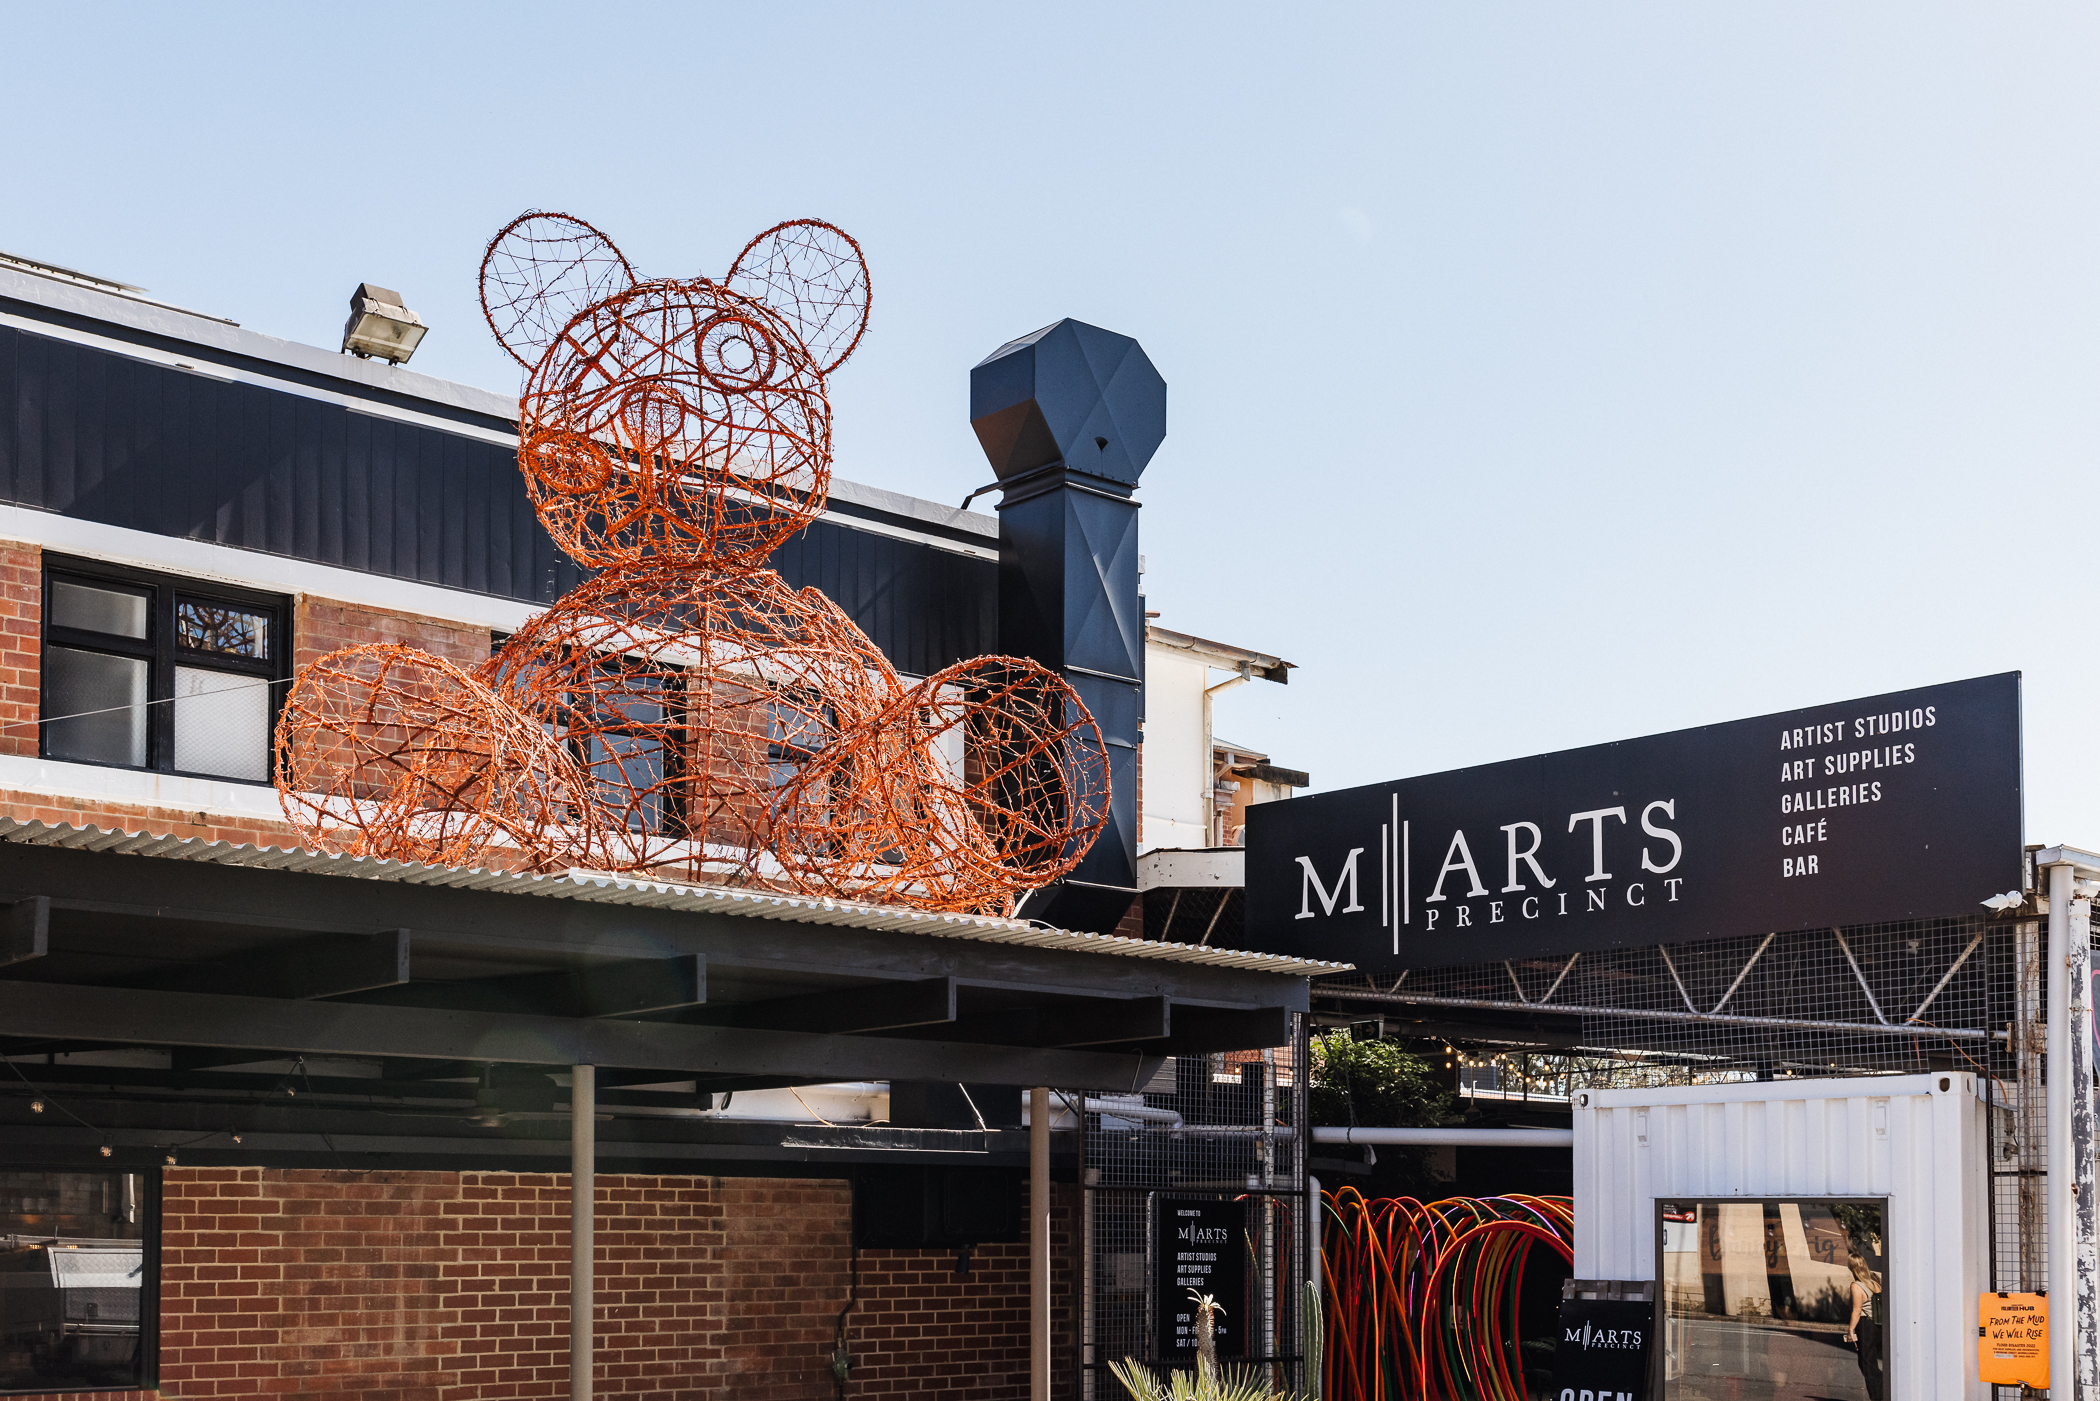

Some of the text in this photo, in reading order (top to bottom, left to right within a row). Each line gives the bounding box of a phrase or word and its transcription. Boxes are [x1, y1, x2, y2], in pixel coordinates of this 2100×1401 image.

[1781, 706, 1936, 750] ARTIST STUDIOS
[1781, 742, 1915, 782] ART SUPPLIES
[1781, 781, 1882, 814] GALLERIES
[1782, 817, 1828, 846] CAFÉ
[1783, 854, 1819, 878] BAR
[1425, 878, 1683, 931] PRECINCT
[1177, 1252, 1217, 1261] ARTIST STUDIOS
[1177, 1265, 1212, 1274] ART SUPPLIES
[1176, 1277, 1204, 1287] GALLERIES
[1176, 1313, 1190, 1322] OPEN
[1989, 1314, 2045, 1326] FROM THE MUD
[1176, 1326, 1188, 1335] MON
[1992, 1328, 2043, 1340] WE WILL RISE
[1176, 1338, 1186, 1347] SAT
[1591, 1342, 1641, 1350] PRECINCT
